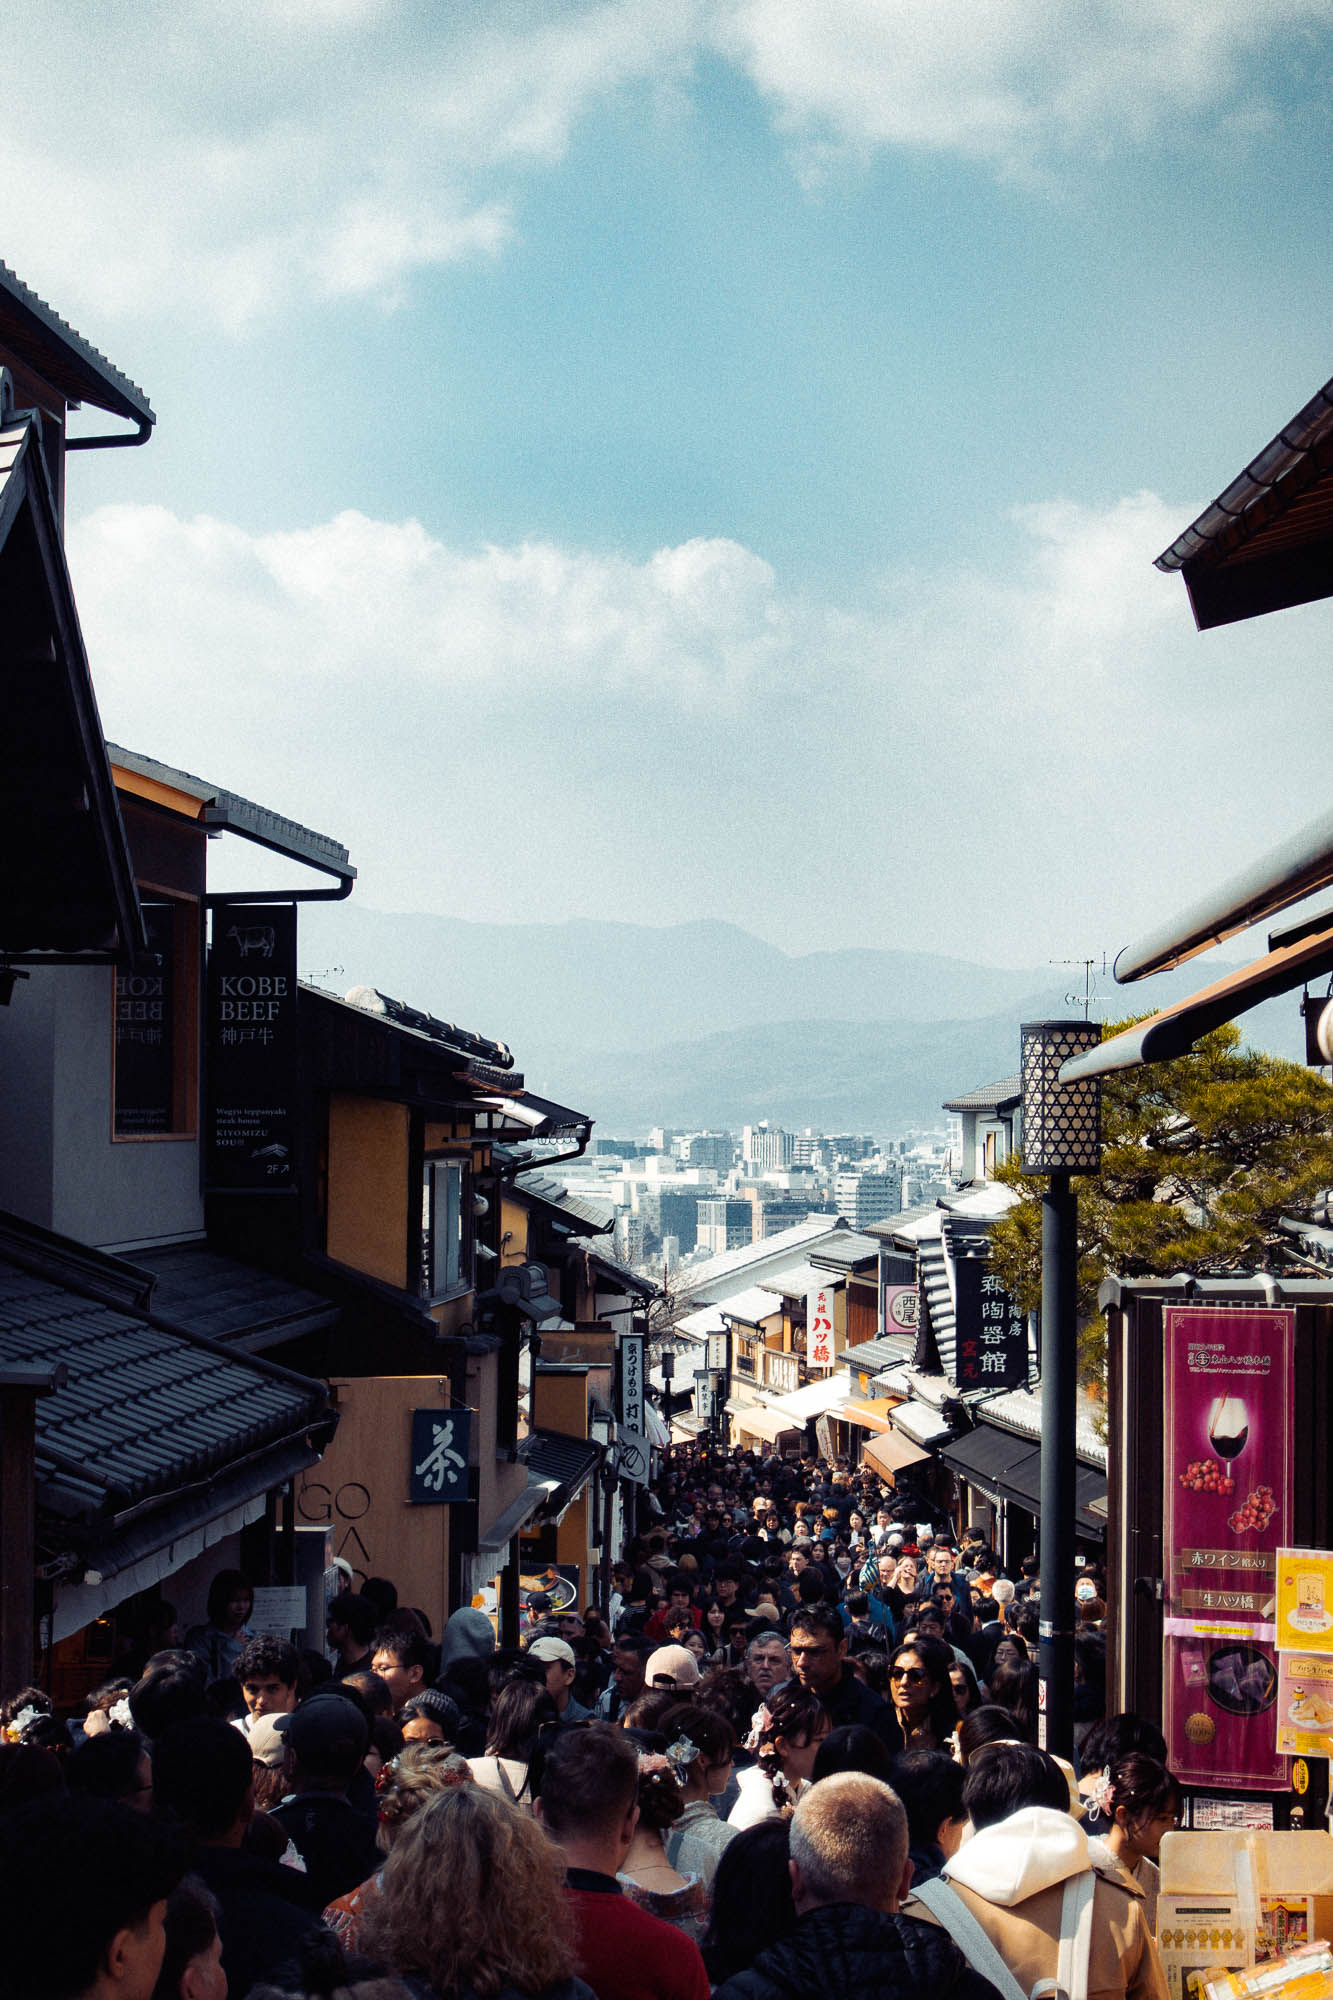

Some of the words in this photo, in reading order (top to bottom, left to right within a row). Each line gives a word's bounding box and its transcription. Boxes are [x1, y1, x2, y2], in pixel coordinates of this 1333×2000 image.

[220, 976, 288, 997] KOBE
[220, 1001, 280, 1021] BEEF
[221, 1027, 275, 1045] 神戸牛
[216, 1129, 269, 1137] KIYOMIZU
[266, 1164, 279, 1174] 2F
[816, 1292, 828, 1314] 元祖
[901, 1295, 917, 1323] 西尾
[627, 1343, 638, 1397] 京つけもの
[297, 1482, 371, 1520] GO
